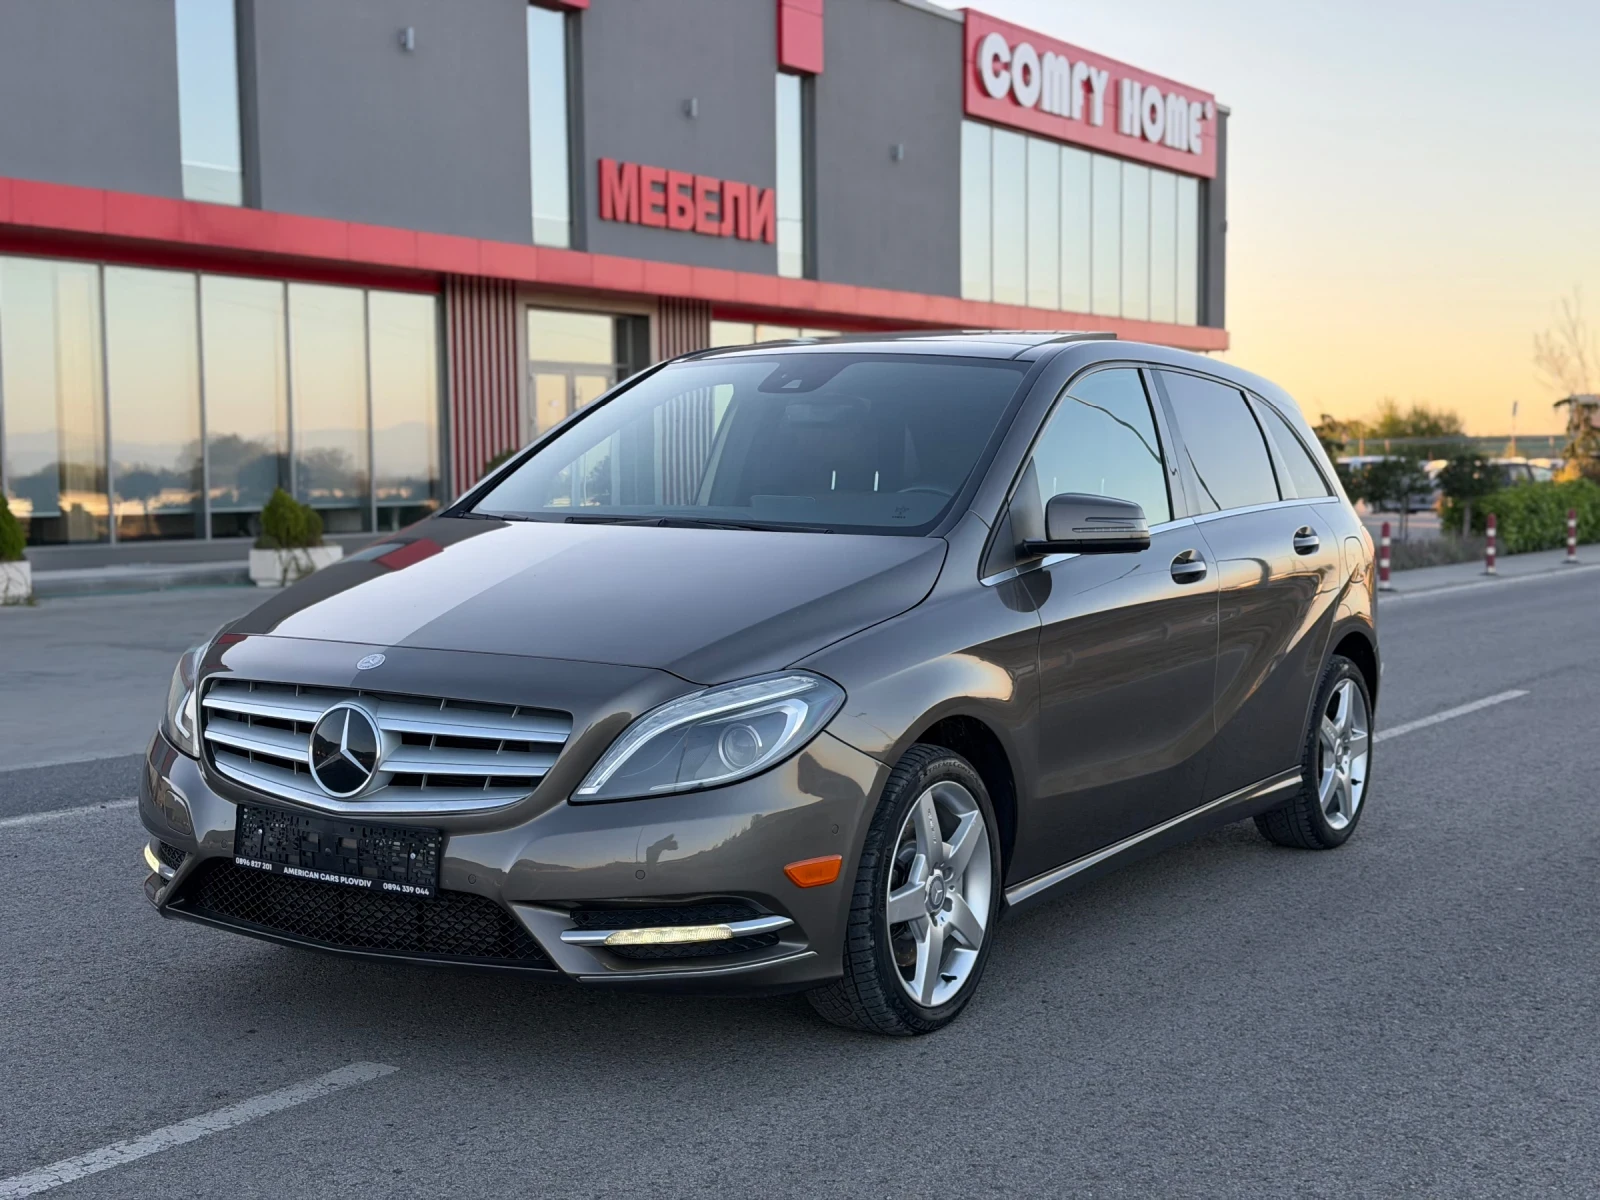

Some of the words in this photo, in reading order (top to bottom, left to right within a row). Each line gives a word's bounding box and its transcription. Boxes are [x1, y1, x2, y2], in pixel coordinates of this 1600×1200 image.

[978, 32, 1108, 127] COMFY
[598, 157, 775, 244] МЕБЕЛИ
[235, 857, 250, 867] 0896
[251, 860, 261, 868] 827
[262, 862, 272, 871] 201
[283, 866, 319, 879] AMERICAN
[320, 873, 339, 883] CARS
[340, 876, 372, 888] PLOVDIV
[383, 882, 401, 891] 0894
[402, 885, 414, 893] 339
[415, 887, 430, 896] 044
